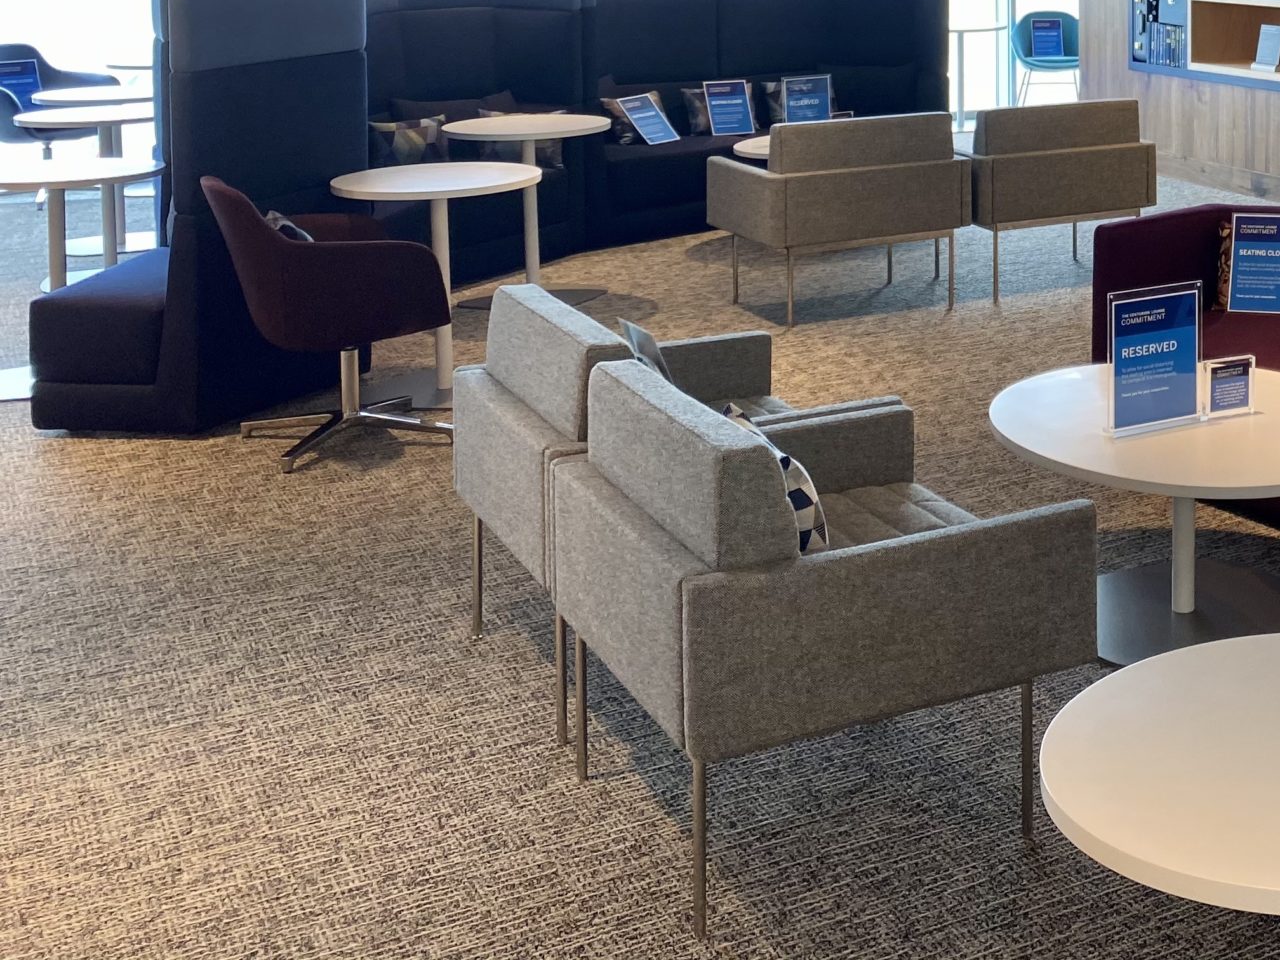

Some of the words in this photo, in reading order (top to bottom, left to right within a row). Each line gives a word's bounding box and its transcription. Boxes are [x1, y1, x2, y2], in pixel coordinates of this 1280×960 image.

[1239, 248, 1266, 257] SEATING
[1120, 312, 1166, 326] COMMITMENT
[1121, 340, 1178, 359] RESERVED
